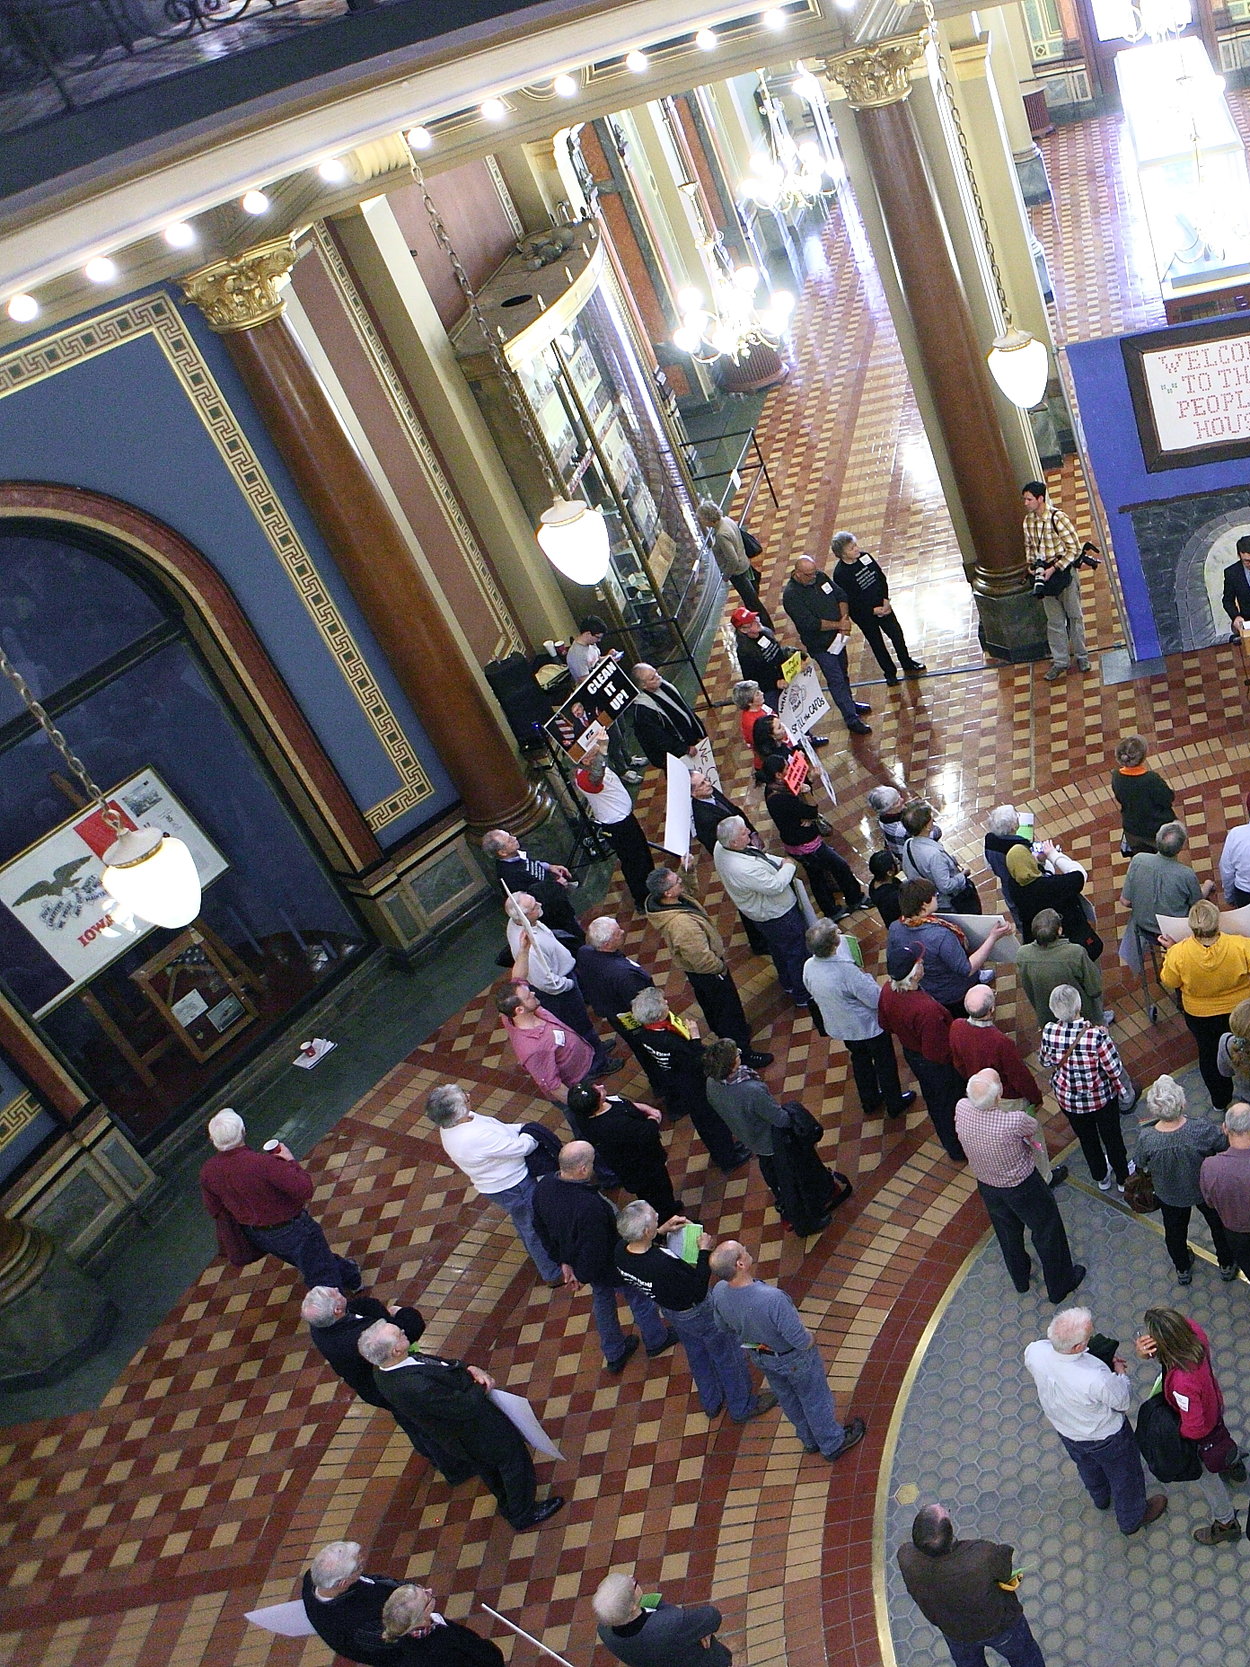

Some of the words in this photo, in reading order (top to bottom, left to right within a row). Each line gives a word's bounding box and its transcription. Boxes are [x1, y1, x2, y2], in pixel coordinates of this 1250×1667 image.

[1182, 372, 1212, 394] TO
[587, 661, 617, 695] CLEAN
[603, 681, 617, 697] IT
[609, 689, 629, 711] UP!
